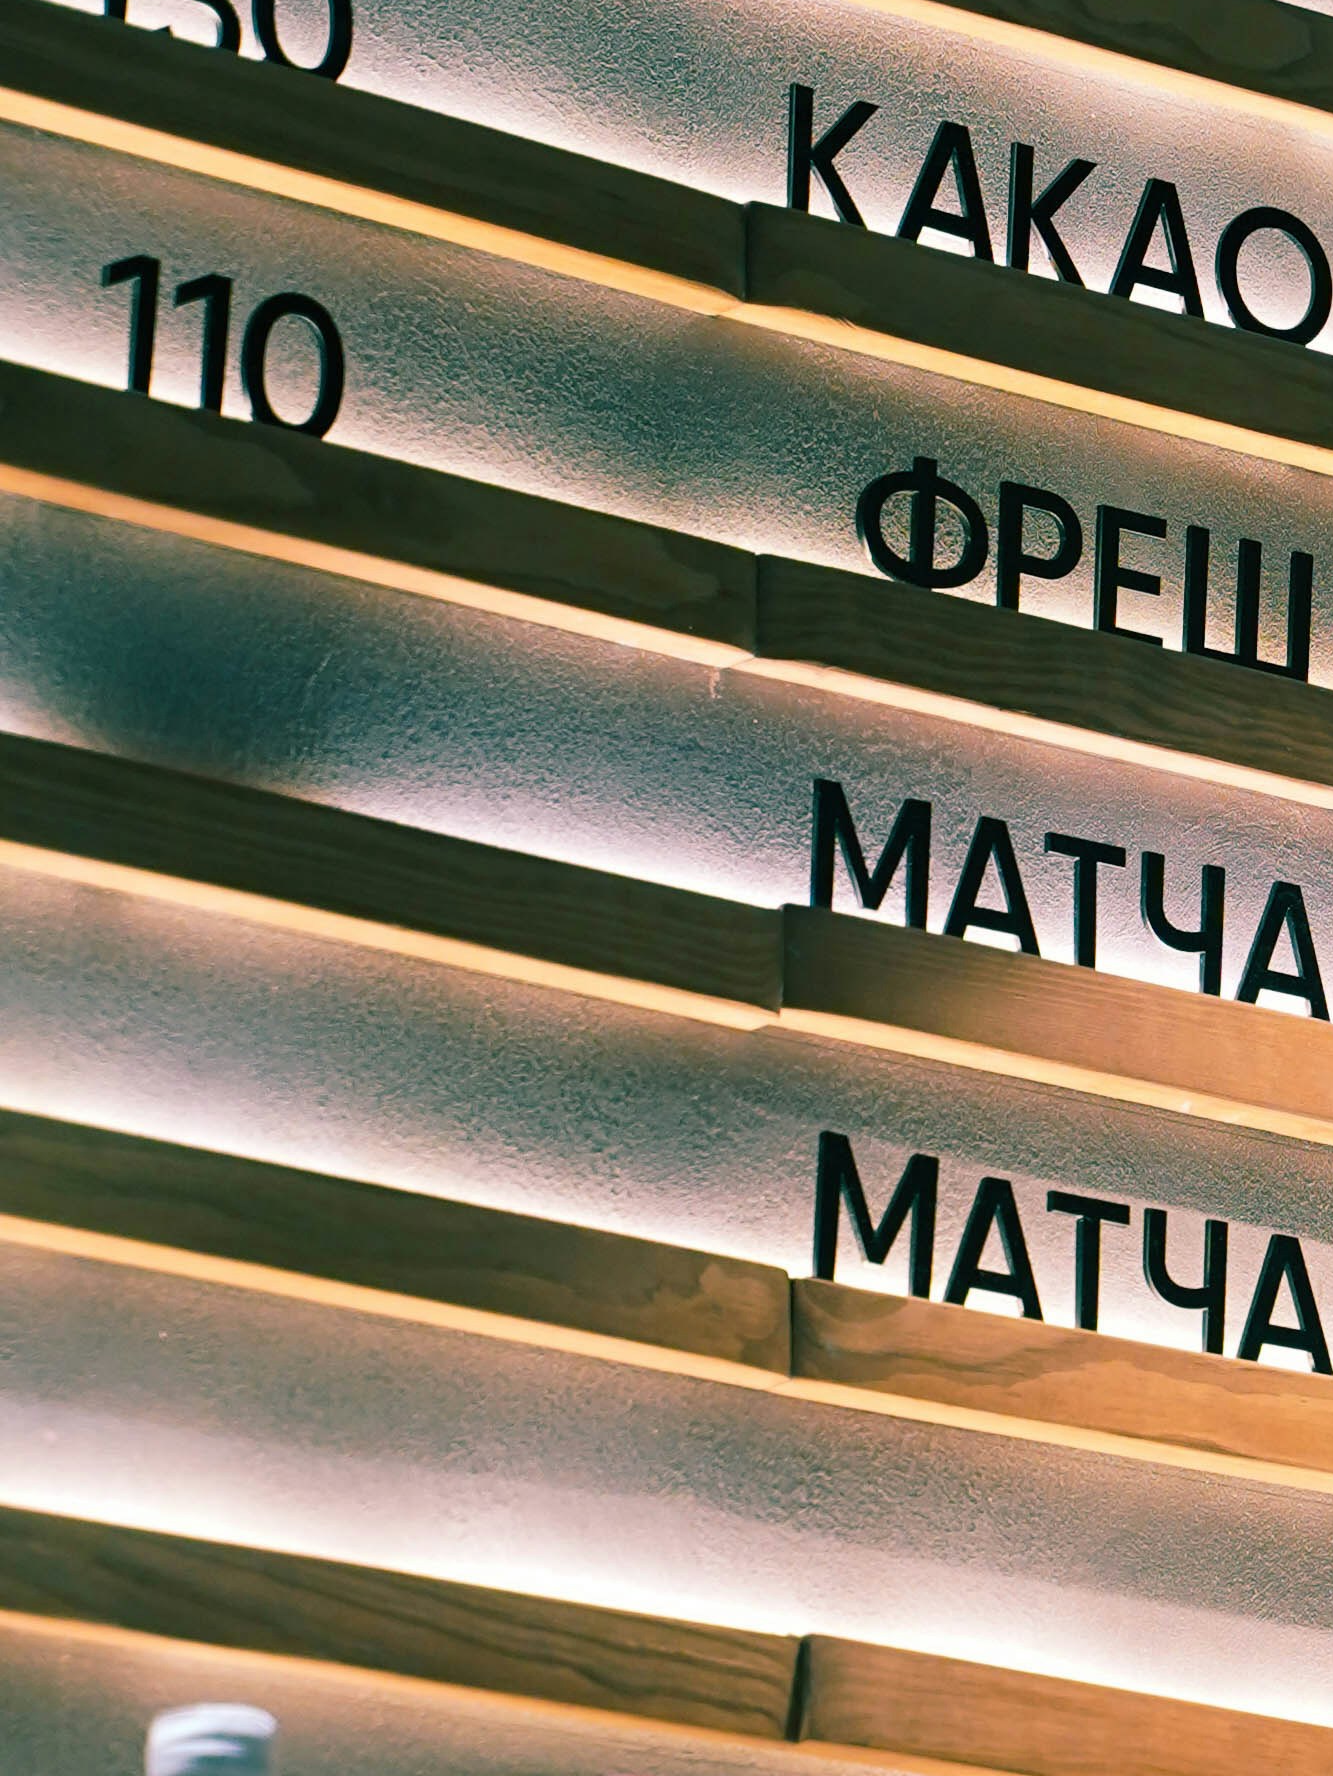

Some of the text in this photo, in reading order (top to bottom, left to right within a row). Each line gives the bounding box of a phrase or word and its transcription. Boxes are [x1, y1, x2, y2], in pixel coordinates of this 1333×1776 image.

[787, 82, 1333, 347] КАКАО
[100, 254, 345, 443] 110
[855, 455, 1313, 683] ФРЕШ
[810, 778, 1331, 1022] МАТЧА
